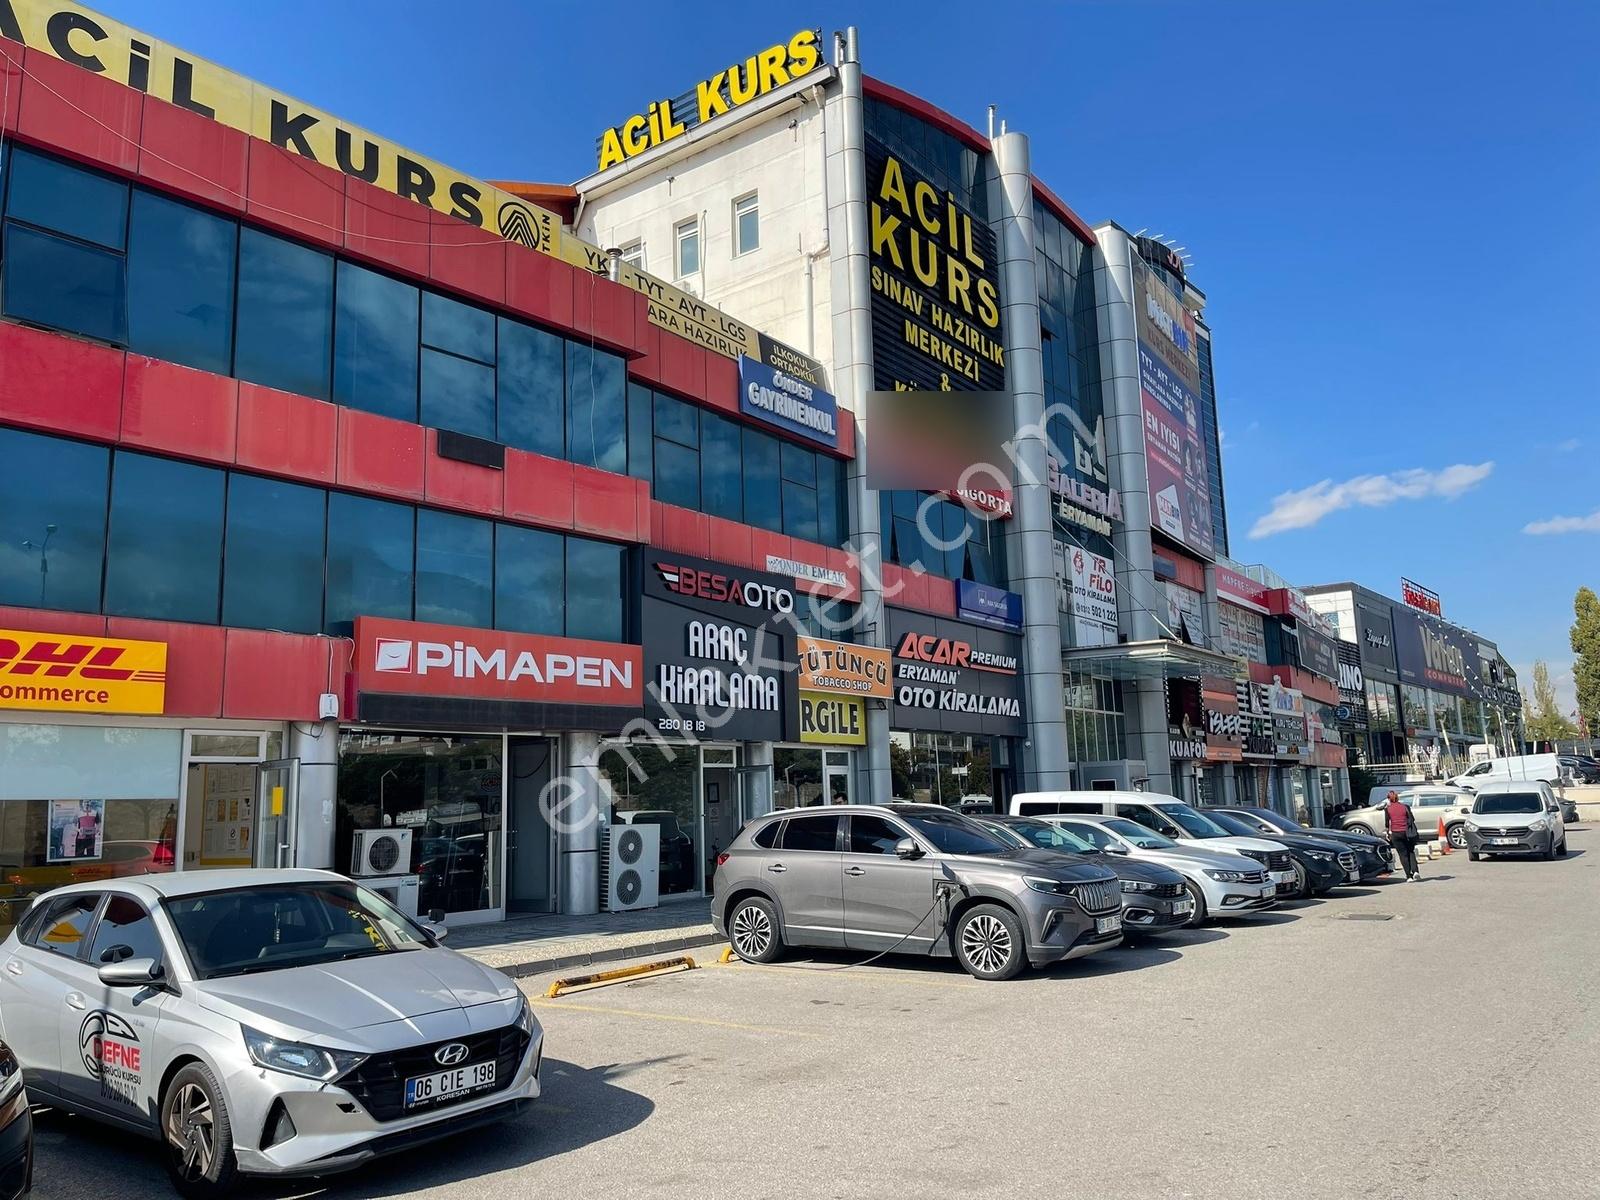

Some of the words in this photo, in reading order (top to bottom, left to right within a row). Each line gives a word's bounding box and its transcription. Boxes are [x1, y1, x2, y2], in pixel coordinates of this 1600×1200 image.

[696, 29, 821, 123] KURS
[270, 99, 484, 228] KURS
[871, 202, 999, 329] KURS
[634, 273, 664, 299] TYT
[679, 297, 707, 323] AYT
[720, 317, 747, 342] LGS
[872, 265, 923, 316] SINAV
[932, 303, 1005, 368] HAZIRLIK
[905, 319, 980, 382] MERKEZİ
[773, 371, 812, 401] ÖNDER
[811, 567, 846, 586] EMLAK
[1092, 556, 1106, 575] TR
[1074, 586, 1086, 597] OTO
[689, 620, 748, 667] ARAÇ
[898, 631, 972, 668] ACAR
[970, 650, 1017, 669] PREMIUM
[812, 675, 852, 690] TOBACCO
[852, 680, 873, 692] SHOP
[900, 685, 935, 708] OTO
[658, 718, 680, 731] 280
[683, 719, 693, 731] 18
[696, 720, 706, 732] 18
[1169, 738, 1207, 758] KUAFÖR
[93, 1038, 141, 1071] DEFNE
[416, 1078, 432, 1099] 06
[441, 1070, 465, 1092] CIE
[473, 1063, 494, 1084] 198
[436, 1089, 471, 1102] KORESAN
